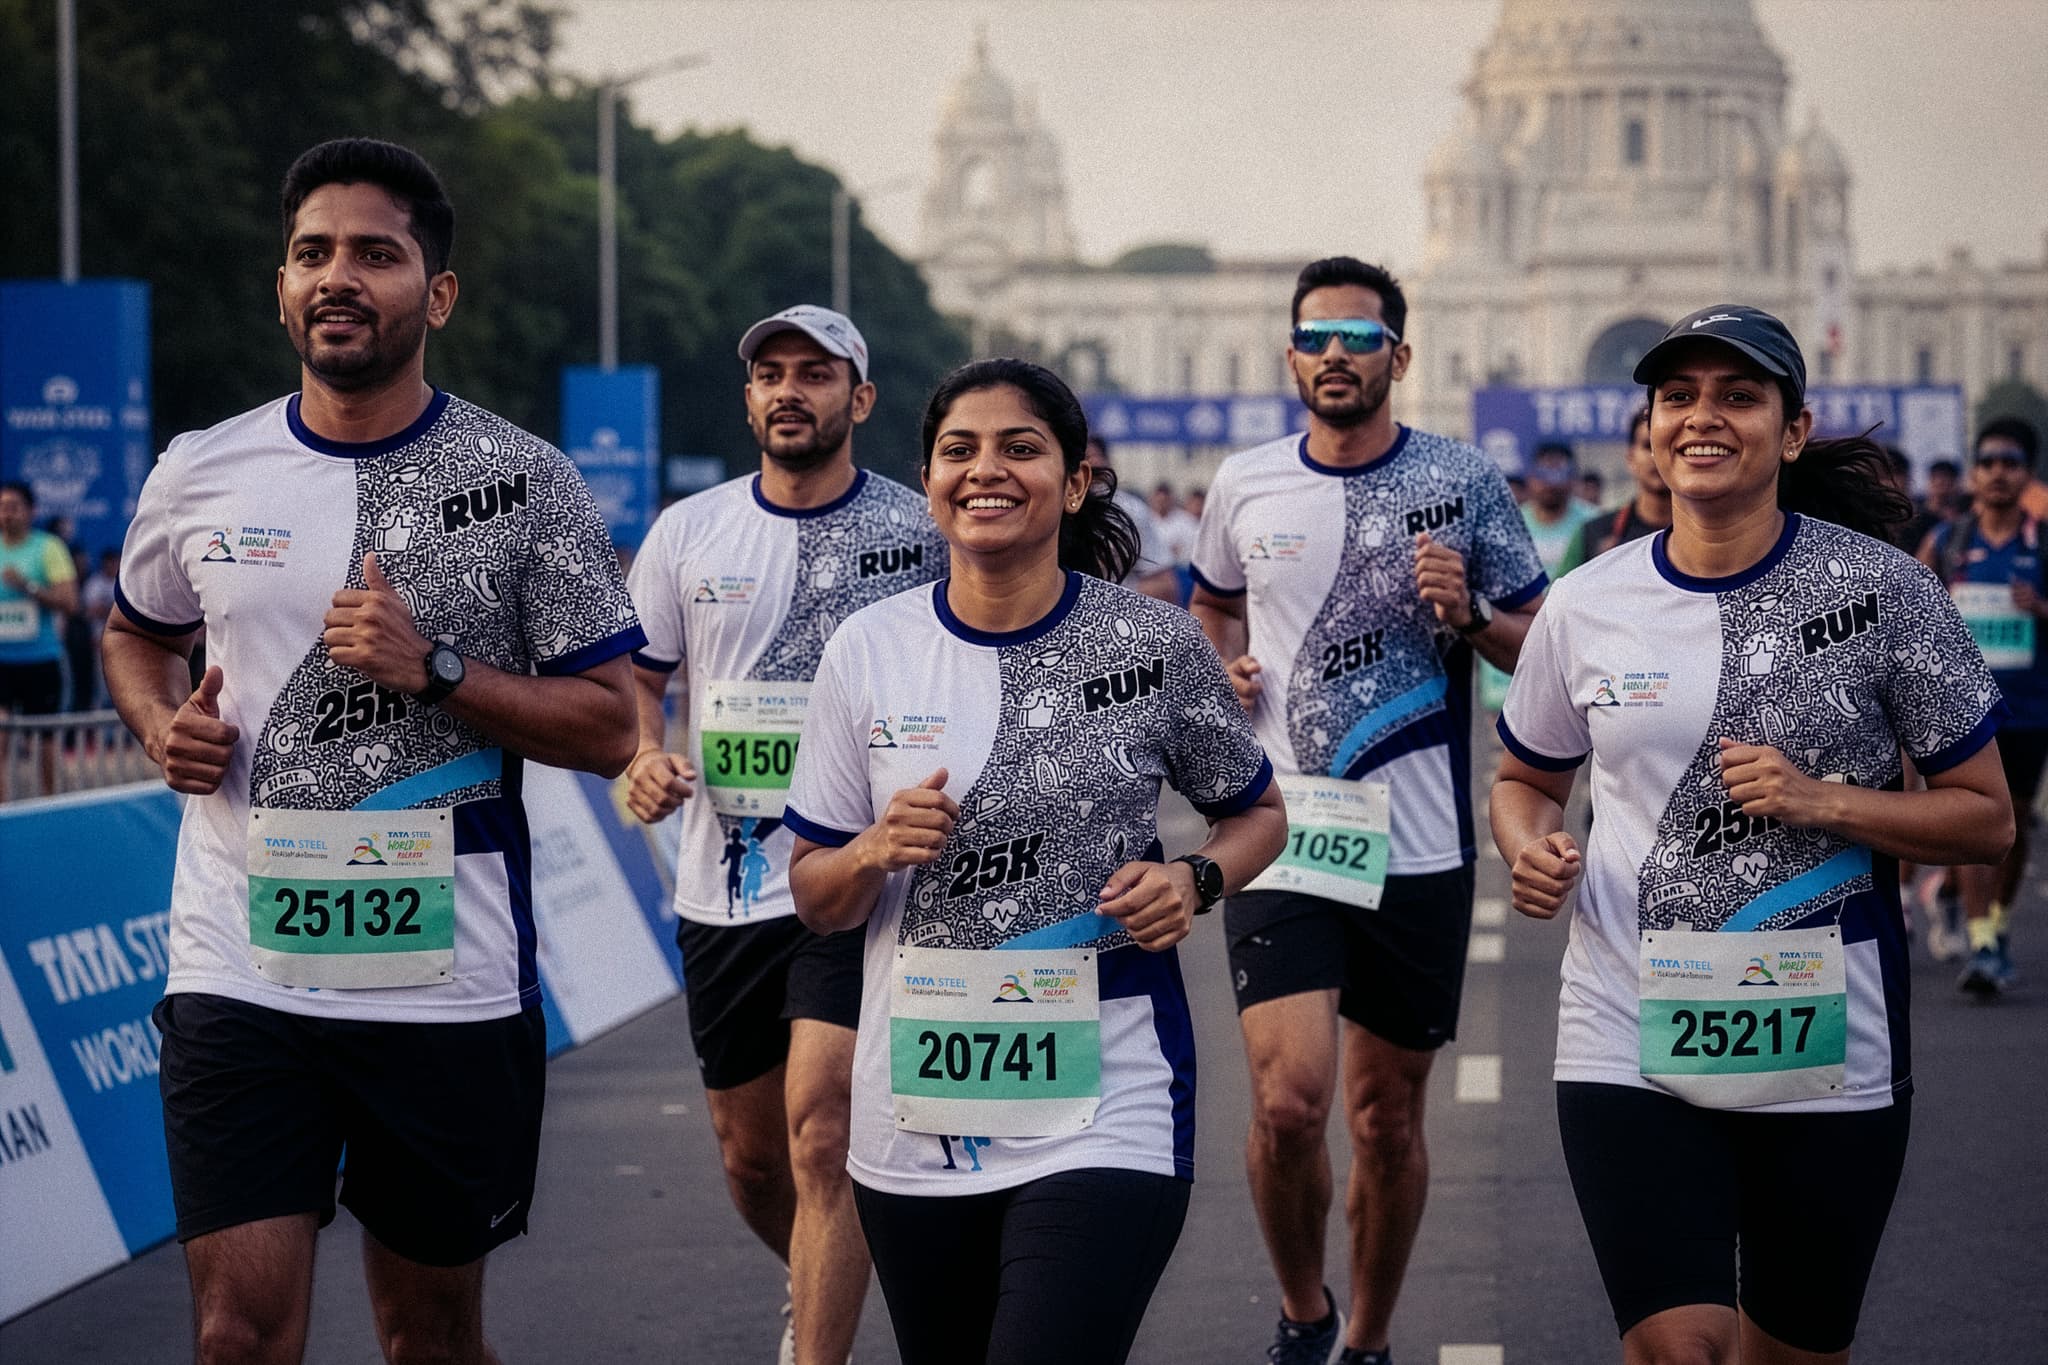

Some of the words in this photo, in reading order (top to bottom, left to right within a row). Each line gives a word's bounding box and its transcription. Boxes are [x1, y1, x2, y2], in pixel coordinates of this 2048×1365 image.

[441, 472, 528, 534] RUN
[1405, 496, 1464, 536] RUN
[859, 543, 923, 579] RUN
[1800, 591, 1880, 657] RUN
[1322, 628, 1385, 682] 25K
[1081, 658, 1165, 713] RUN
[264, 838, 295, 848] TATA
[298, 839, 328, 850] STEEL
[387, 839, 415, 850] WORLD
[1291, 831, 1370, 870] 1052
[948, 831, 1046, 900] 25K
[274, 887, 421, 937] 25132
[27, 923, 137, 1005] TATA
[904, 975, 935, 986] TATA
[938, 977, 968, 988] STEEL
[1033, 968, 1055, 976] TATA
[1057, 968, 1078, 976] STEEL
[1033, 977, 1061, 988] WORLD
[1649, 958, 1680, 968] TATA
[1683, 960, 1713, 971] STEEL
[1778, 960, 1806, 971] WORLD
[1670, 1006, 1817, 1058] 25217
[918, 1030, 1057, 1082] 20741
